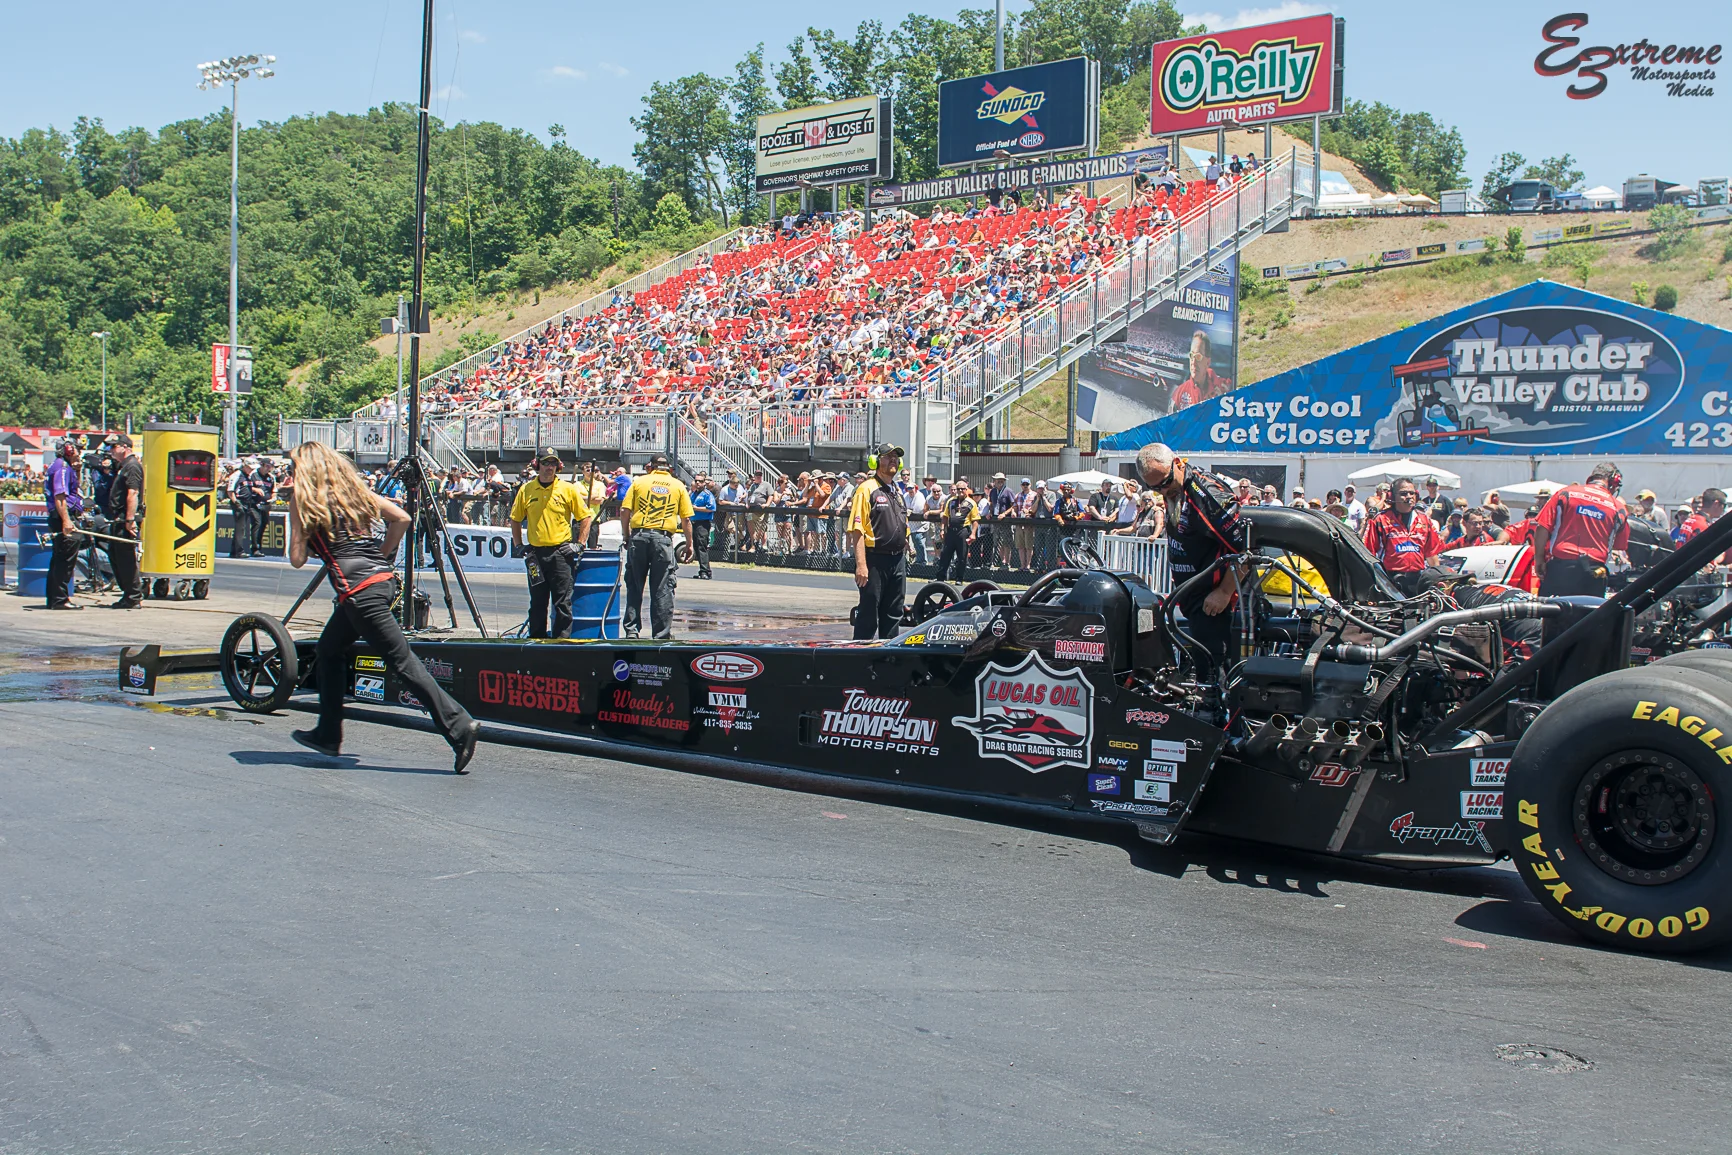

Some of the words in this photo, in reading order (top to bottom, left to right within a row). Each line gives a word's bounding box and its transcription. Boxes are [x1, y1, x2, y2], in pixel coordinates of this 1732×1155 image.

[1167, 48, 1313, 103] O'Reilly
[980, 93, 1043, 117] SUNOCO
[1206, 108, 1236, 123] AUTO
[1238, 102, 1276, 120] PARTS
[761, 132, 793, 150] BOOZE
[795, 131, 804, 144] IT
[827, 127, 835, 139] &
[837, 122, 862, 137] LOSE
[863, 120, 874, 133] IT
[975, 142, 996, 152] Official
[996, 140, 1010, 149] Fuel
[1010, 138, 1018, 147] of
[1021, 133, 1042, 147] NHRA
[769, 159, 781, 167] Lose
[781, 158, 792, 166] your
[811, 154, 822, 162] your
[844, 149, 855, 158] your
[763, 175, 797, 186] GOVERNOR'S
[798, 170, 824, 181] HIGHWAY
[825, 167, 846, 177] SAFETY
[847, 163, 870, 174] OFFICE
[900, 180, 952, 202] THUNDER
[955, 173, 996, 194] VALLEY
[998, 169, 1029, 189] CLUB
[1032, 155, 1128, 185] GRANDSTANDS
[1567, 224, 1592, 235] JEGS
[1186, 288, 1230, 312] BERNSTEIN
[1172, 306, 1214, 325] GRANDSTAND
[1453, 334, 1653, 375] Thunder
[1451, 376, 1556, 411] Valley
[1562, 374, 1650, 404] Club
[1219, 395, 1282, 424] Stay
[1289, 395, 1362, 418] Cool
[1551, 404, 1593, 412] BRISTOL
[1596, 404, 1645, 412] DRAGWAY
[1210, 422, 1260, 445] Get
[1267, 422, 1371, 445] Closer
[944, 624, 974, 635] FISCHER
[1055, 640, 1104, 656] BOSTWICK
[659, 666, 672, 674] INDY
[355, 690, 383, 700] CARRILLO
[507, 672, 580, 698] FISCHER
[986, 681, 1047, 704] LUCAS
[1049, 685, 1080, 707] OIL
[508, 689, 581, 714] HONDA
[613, 689, 675, 718] Woody's
[712, 693, 743, 707] VMW
[843, 688, 910, 725] Tommy
[598, 710, 639, 725] CUSTOM
[641, 715, 690, 731] HEADERS
[822, 710, 937, 743] THOMPSON
[818, 734, 940, 756] MOTORSPORTS
[985, 740, 1006, 751] DRAG
[1007, 742, 1027, 753] BOAT
[1027, 744, 1055, 756] RACING
[1056, 747, 1083, 759] SERIES
[1108, 740, 1139, 750] GEICO
[1147, 763, 1173, 773] OPTIMA
[1474, 775, 1499, 783] TRANS
[1466, 794, 1503, 806] LUCA
[1467, 807, 1499, 816] RACING
